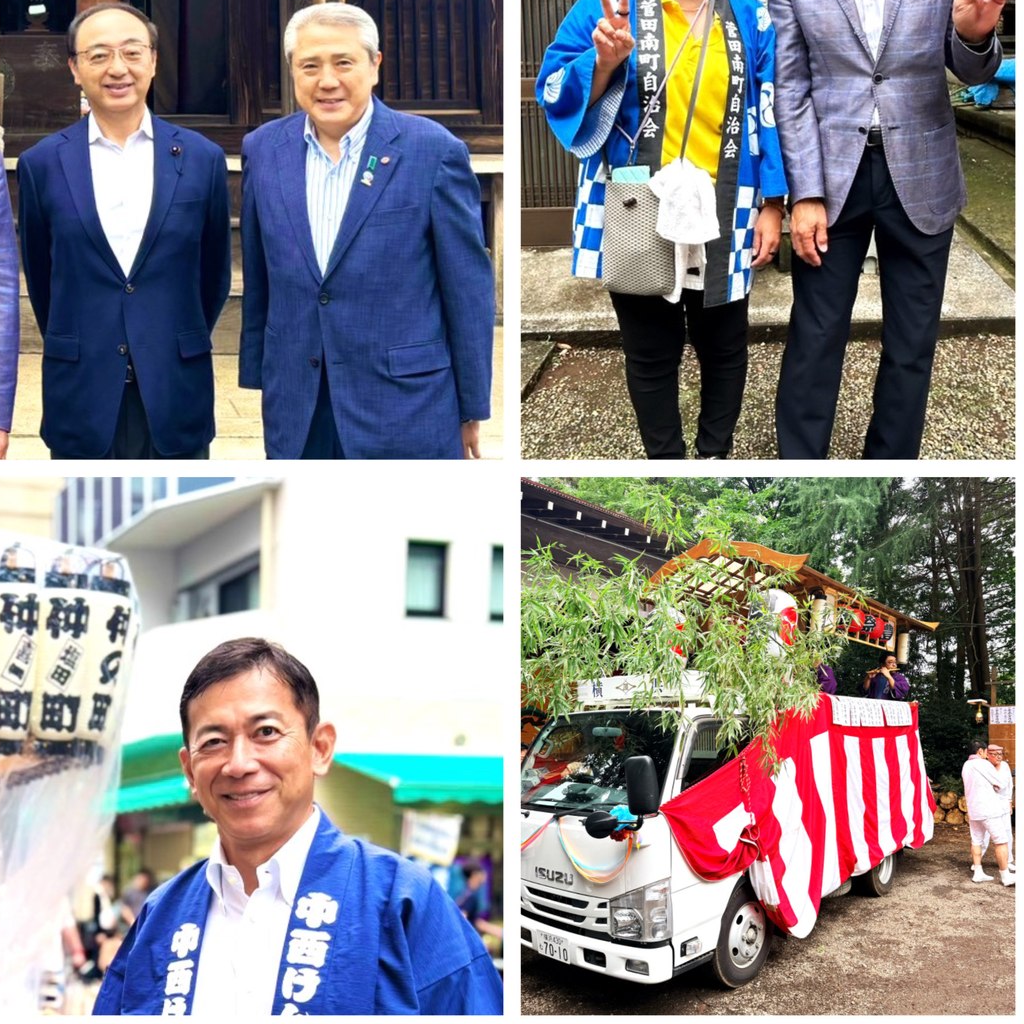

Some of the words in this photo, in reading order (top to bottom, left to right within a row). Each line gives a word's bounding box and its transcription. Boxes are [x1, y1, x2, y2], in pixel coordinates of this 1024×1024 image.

[638, 0, 661, 138] 菅田南町自治会
[724, 21, 745, 158] 菅田南町自治会
[535, 867, 574, 885] ISUZU
